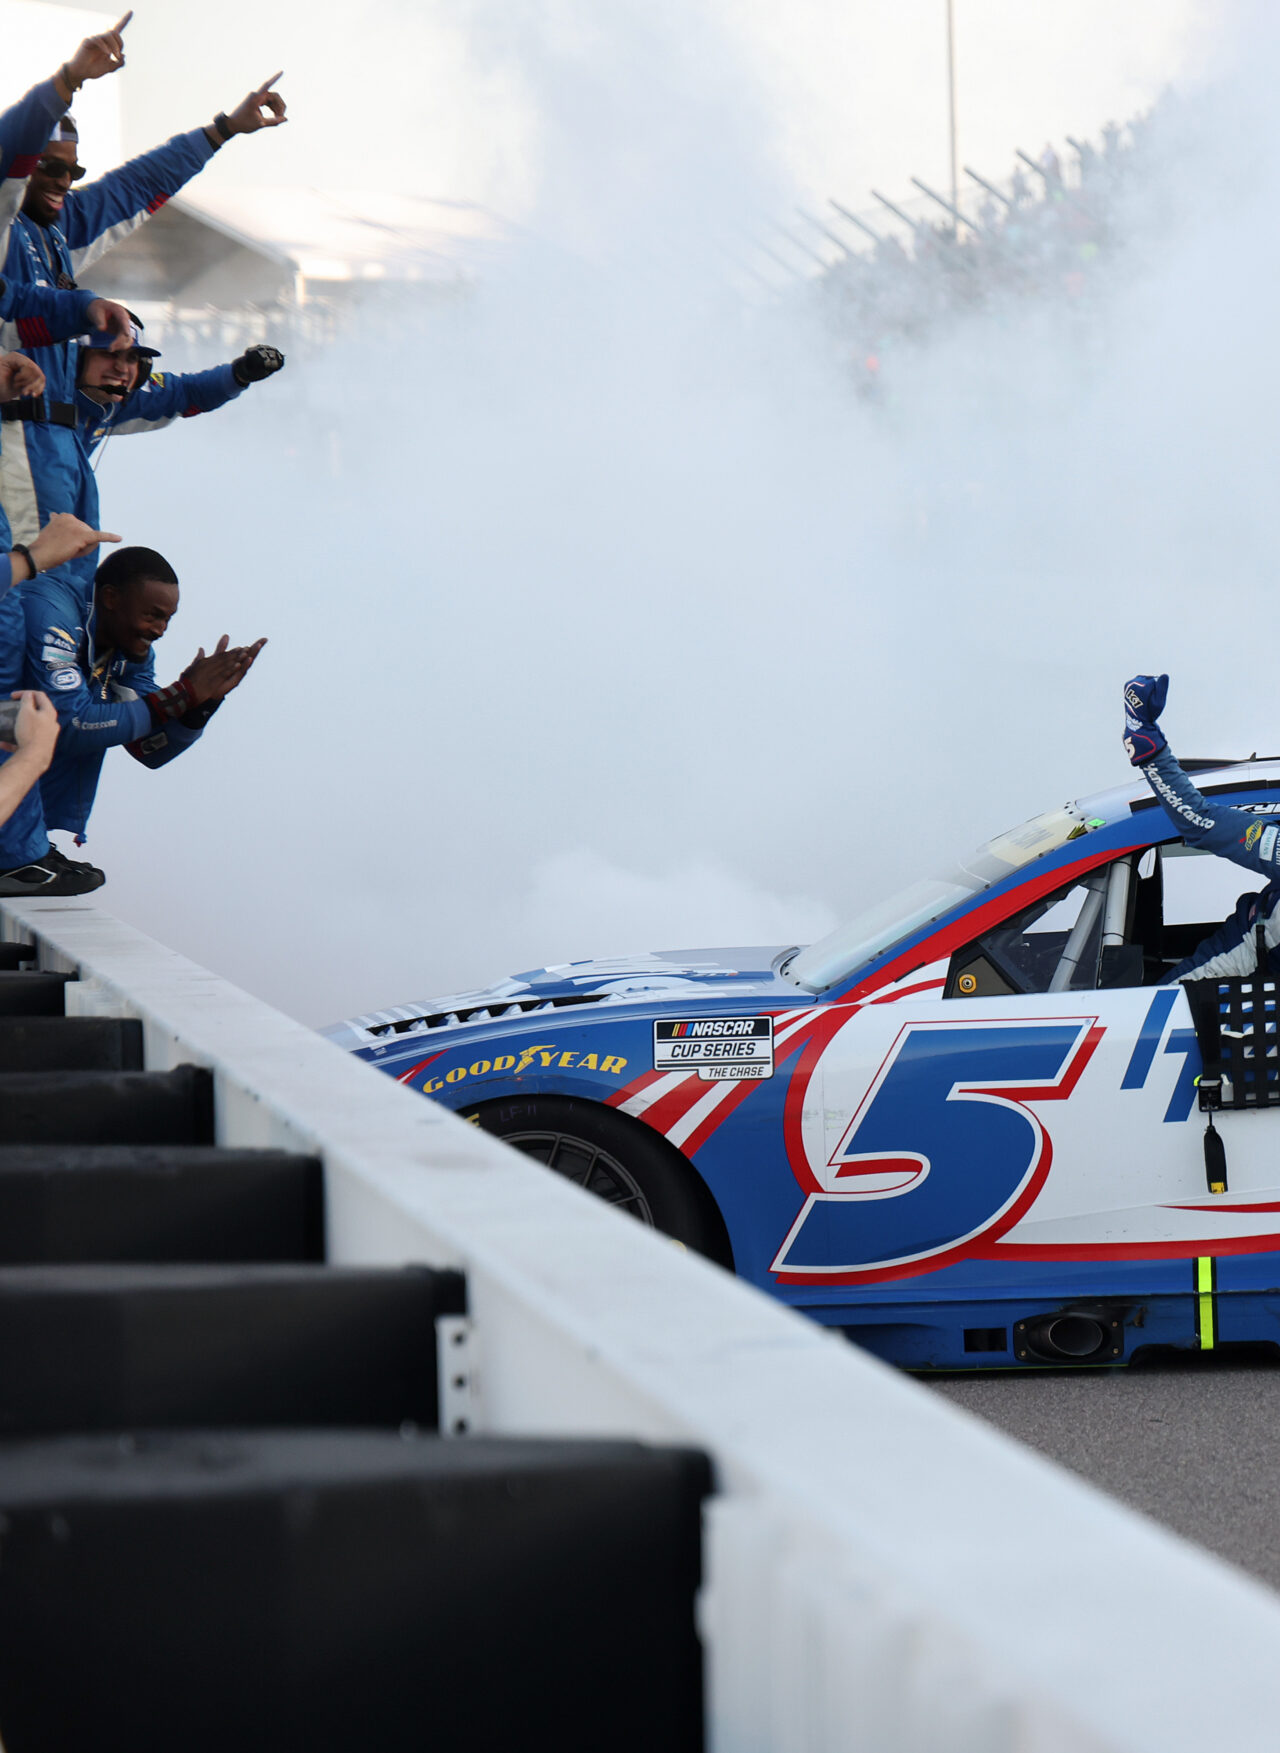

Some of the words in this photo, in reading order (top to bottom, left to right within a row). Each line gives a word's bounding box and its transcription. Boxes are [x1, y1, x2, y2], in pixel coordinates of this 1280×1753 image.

[690, 1021, 755, 1036] NASCAR
[671, 1044, 703, 1058] CUP
[703, 1042, 756, 1057] SERIES
[423, 1044, 628, 1094] GOODYEAR
[708, 1067, 727, 1078] THE
[728, 1066, 764, 1078] CHASE
[769, 1016, 1107, 1286] 5
